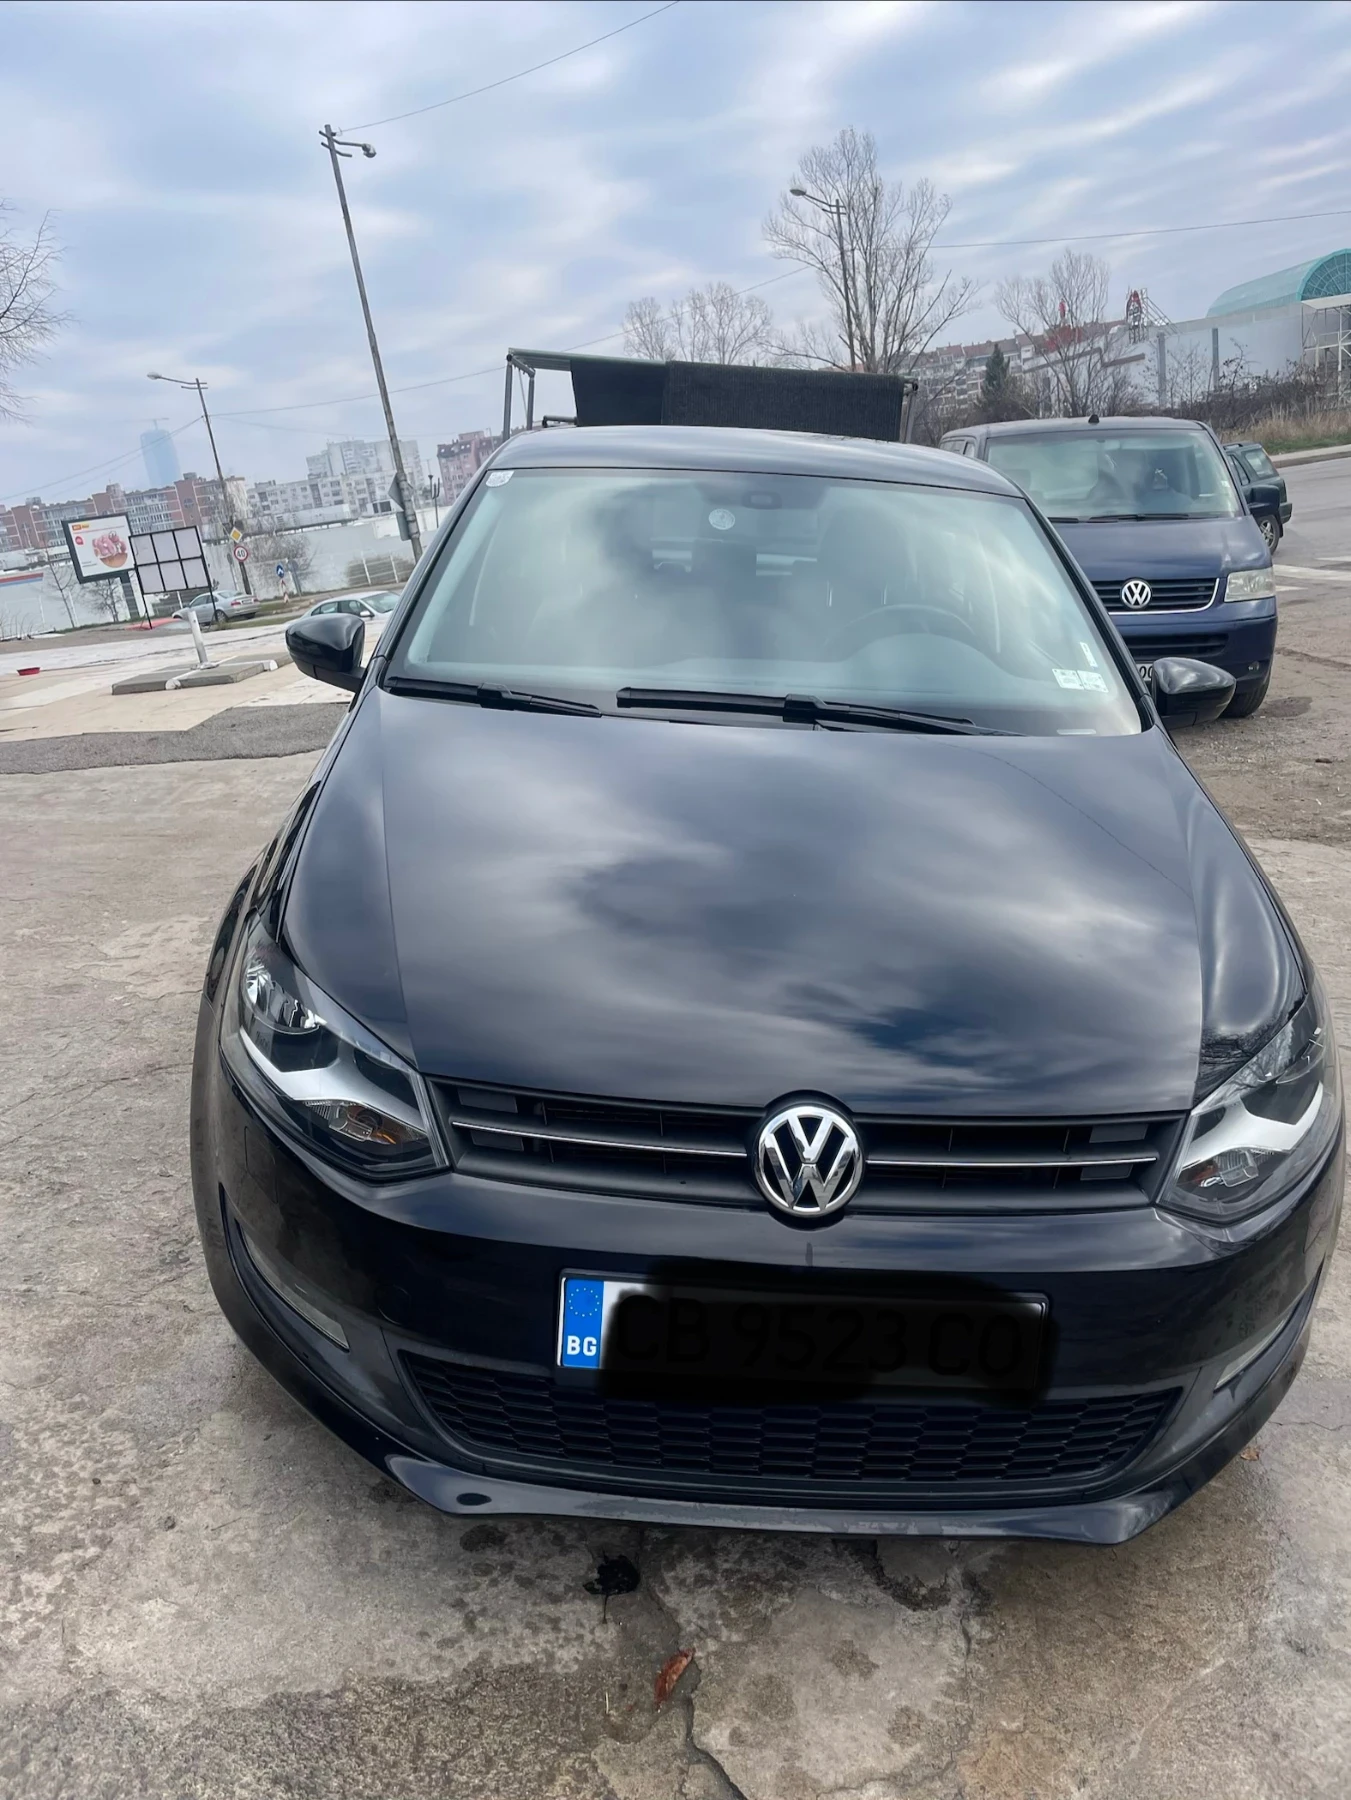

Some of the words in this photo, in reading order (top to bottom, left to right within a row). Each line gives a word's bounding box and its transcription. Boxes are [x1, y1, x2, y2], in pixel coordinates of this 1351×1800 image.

[1121, 580, 1151, 609] VW
[755, 1105, 863, 1217] VW
[566, 1335, 598, 1357] BG
